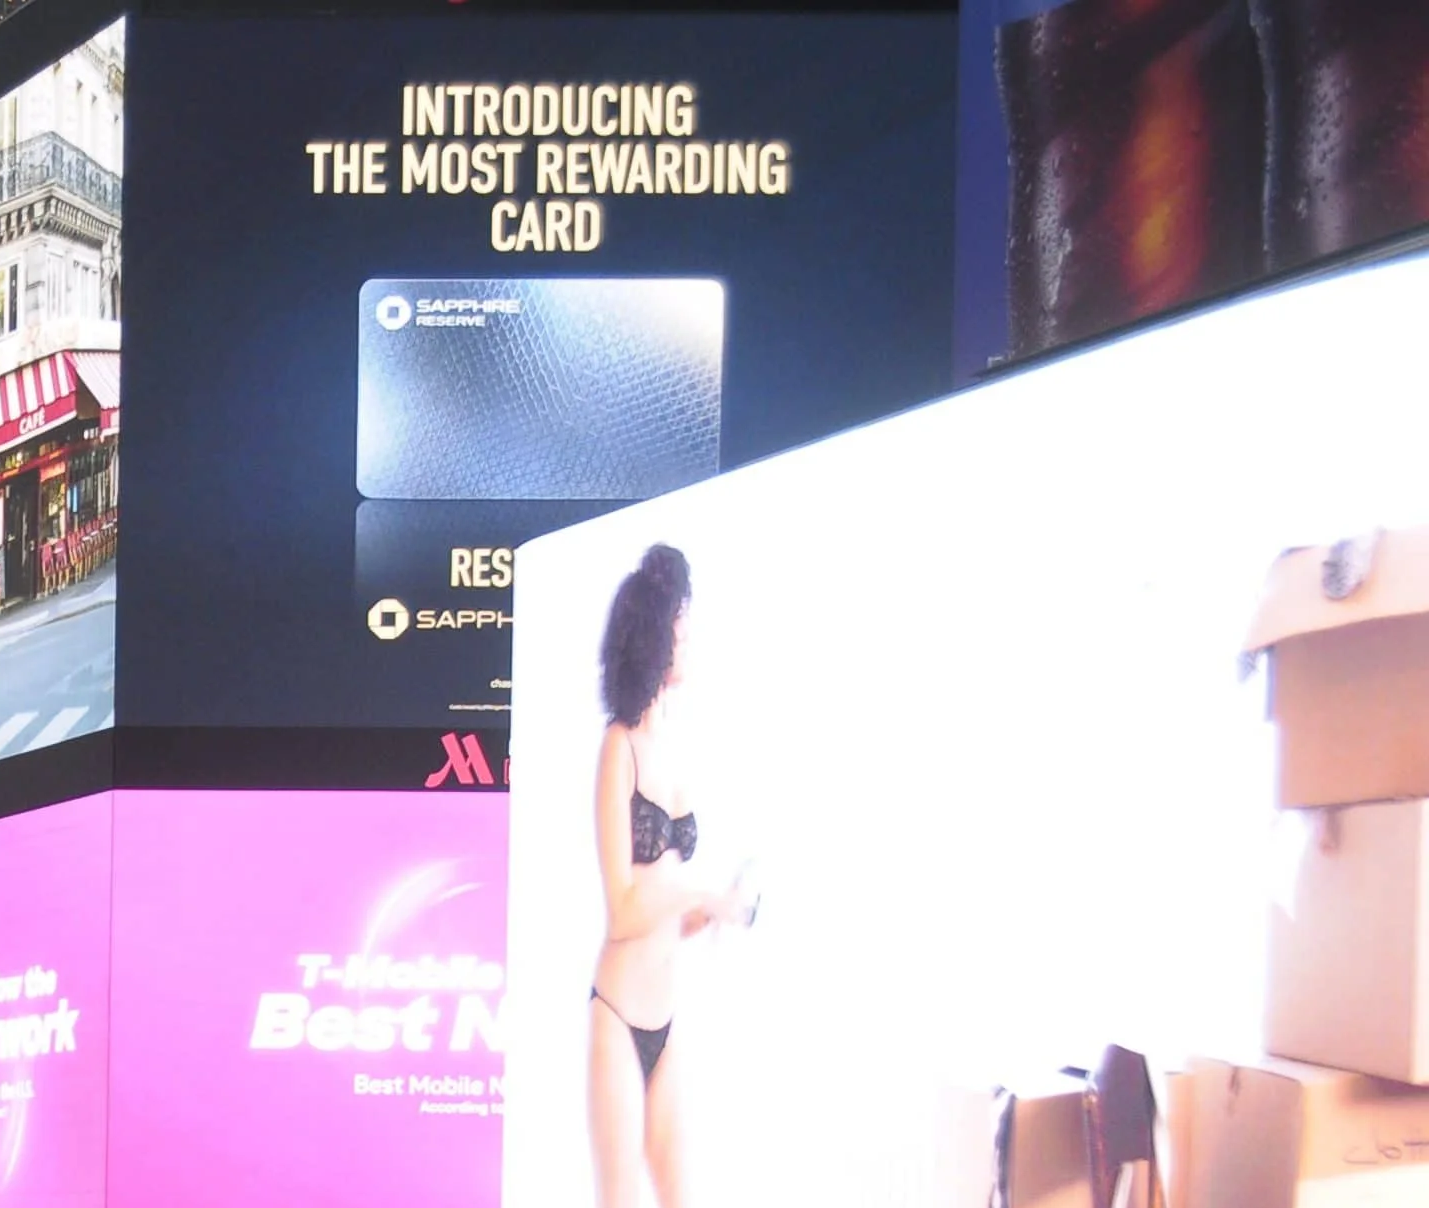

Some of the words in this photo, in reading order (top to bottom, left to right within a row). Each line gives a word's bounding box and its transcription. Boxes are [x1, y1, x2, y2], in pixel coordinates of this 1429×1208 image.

[401, 84, 697, 137] INTRODUCING
[304, 142, 387, 195] THE
[401, 142, 523, 195] MOST
[535, 142, 791, 195] REWARDING
[489, 199, 605, 252] CARD
[415, 299, 521, 314] SAPPHIRE
[415, 315, 486, 328] RESERVE
[297, 953, 505, 991] T-Mobile
[249, 992, 439, 1052] Best
[353, 1073, 404, 1095] Best
[408, 1074, 485, 1096] Mobile
